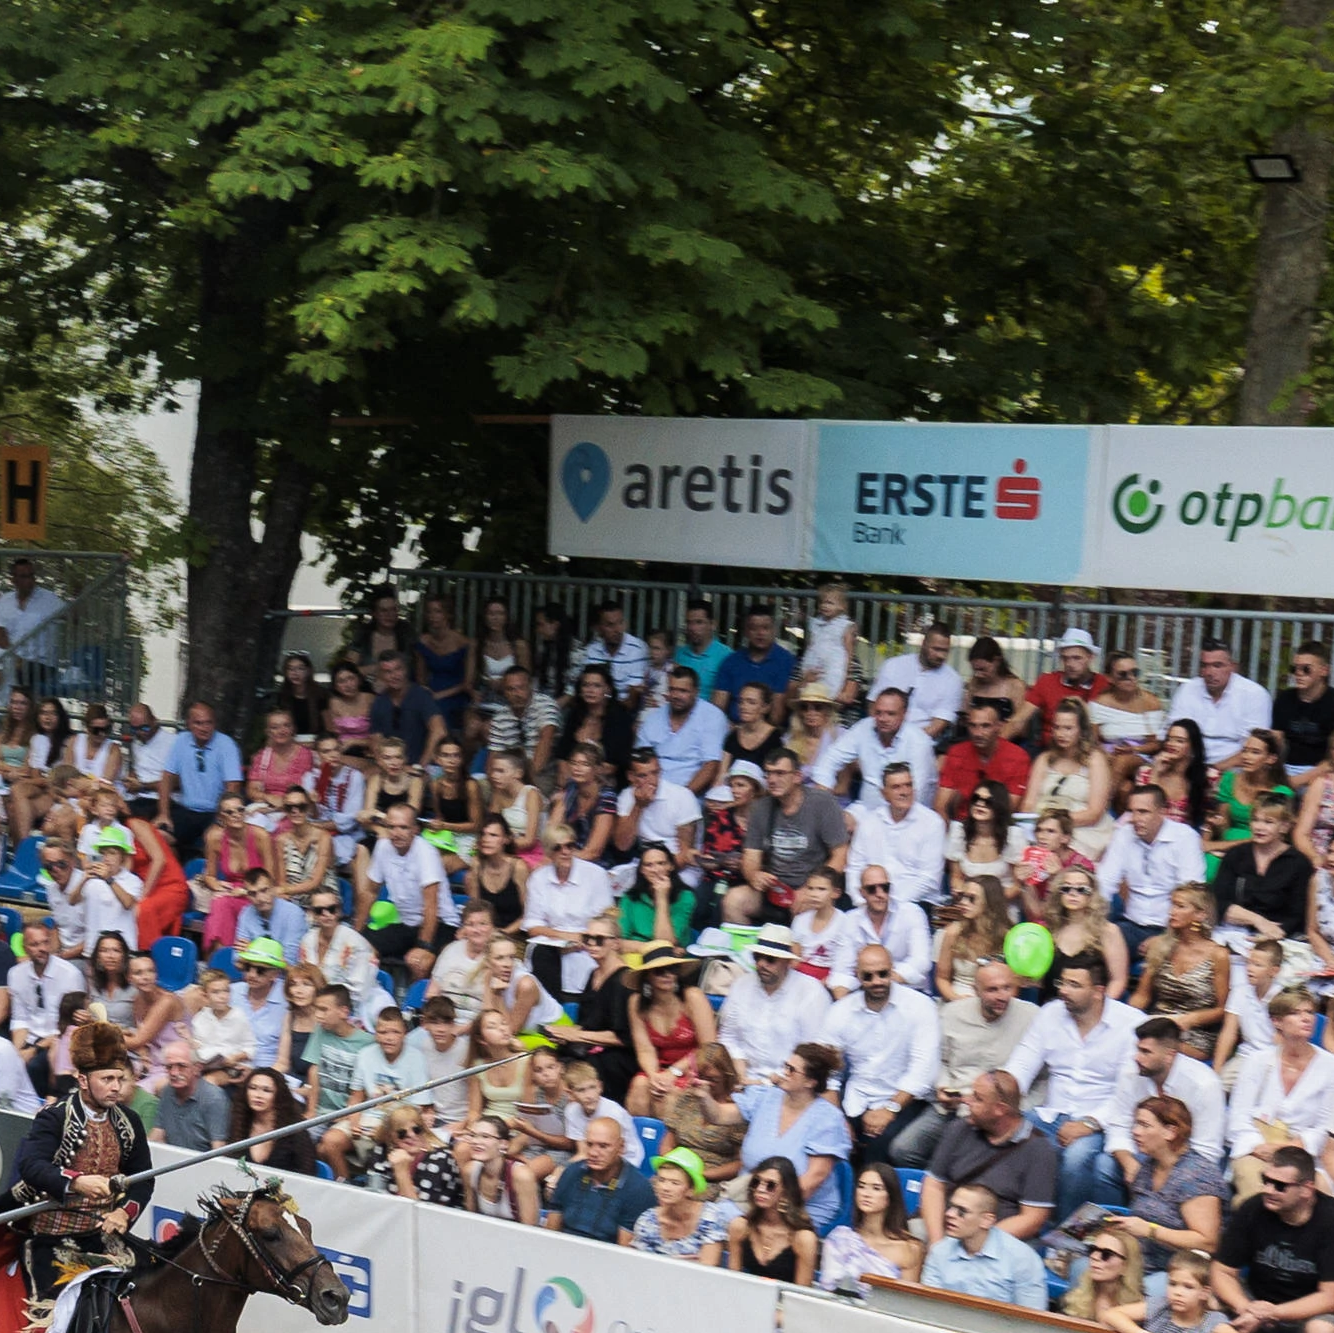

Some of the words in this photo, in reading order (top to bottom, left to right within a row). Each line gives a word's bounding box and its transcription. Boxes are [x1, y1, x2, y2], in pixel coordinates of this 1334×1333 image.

[7, 459, 41, 524] H
[622, 454, 794, 517] aretis
[855, 472, 987, 520] ERSTE
[854, 521, 907, 546] Bank
